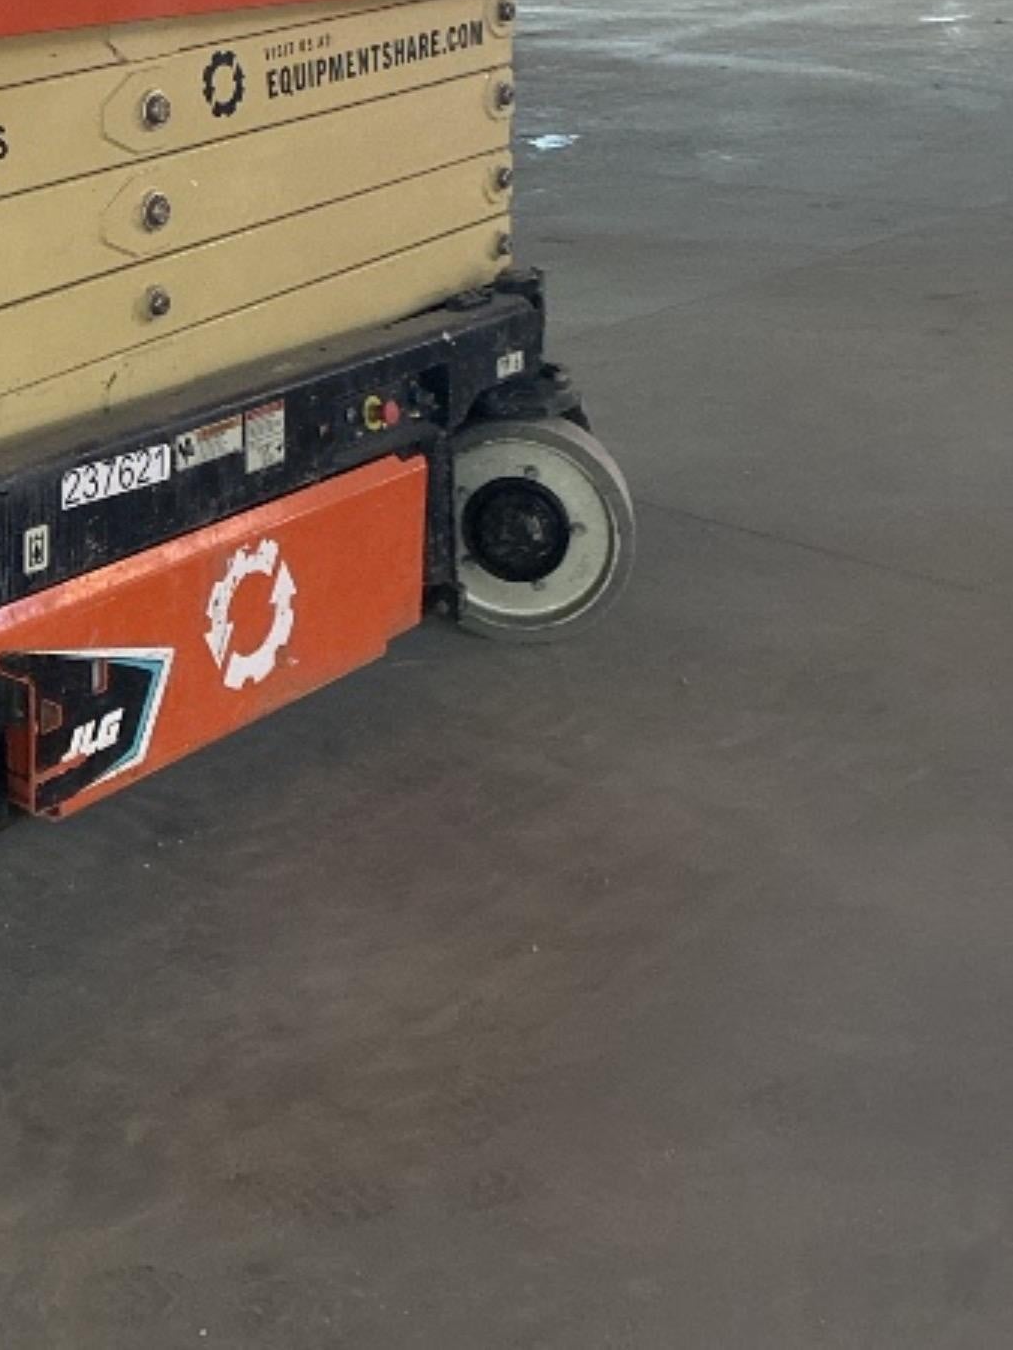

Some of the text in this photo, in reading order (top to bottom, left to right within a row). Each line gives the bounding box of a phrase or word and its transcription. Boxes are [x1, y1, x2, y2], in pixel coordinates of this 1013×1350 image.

[266, 20, 483, 98] EQUIPMENTSHARE.COM
[64, 446, 166, 505] 237621
[60, 706, 126, 764] JLG
